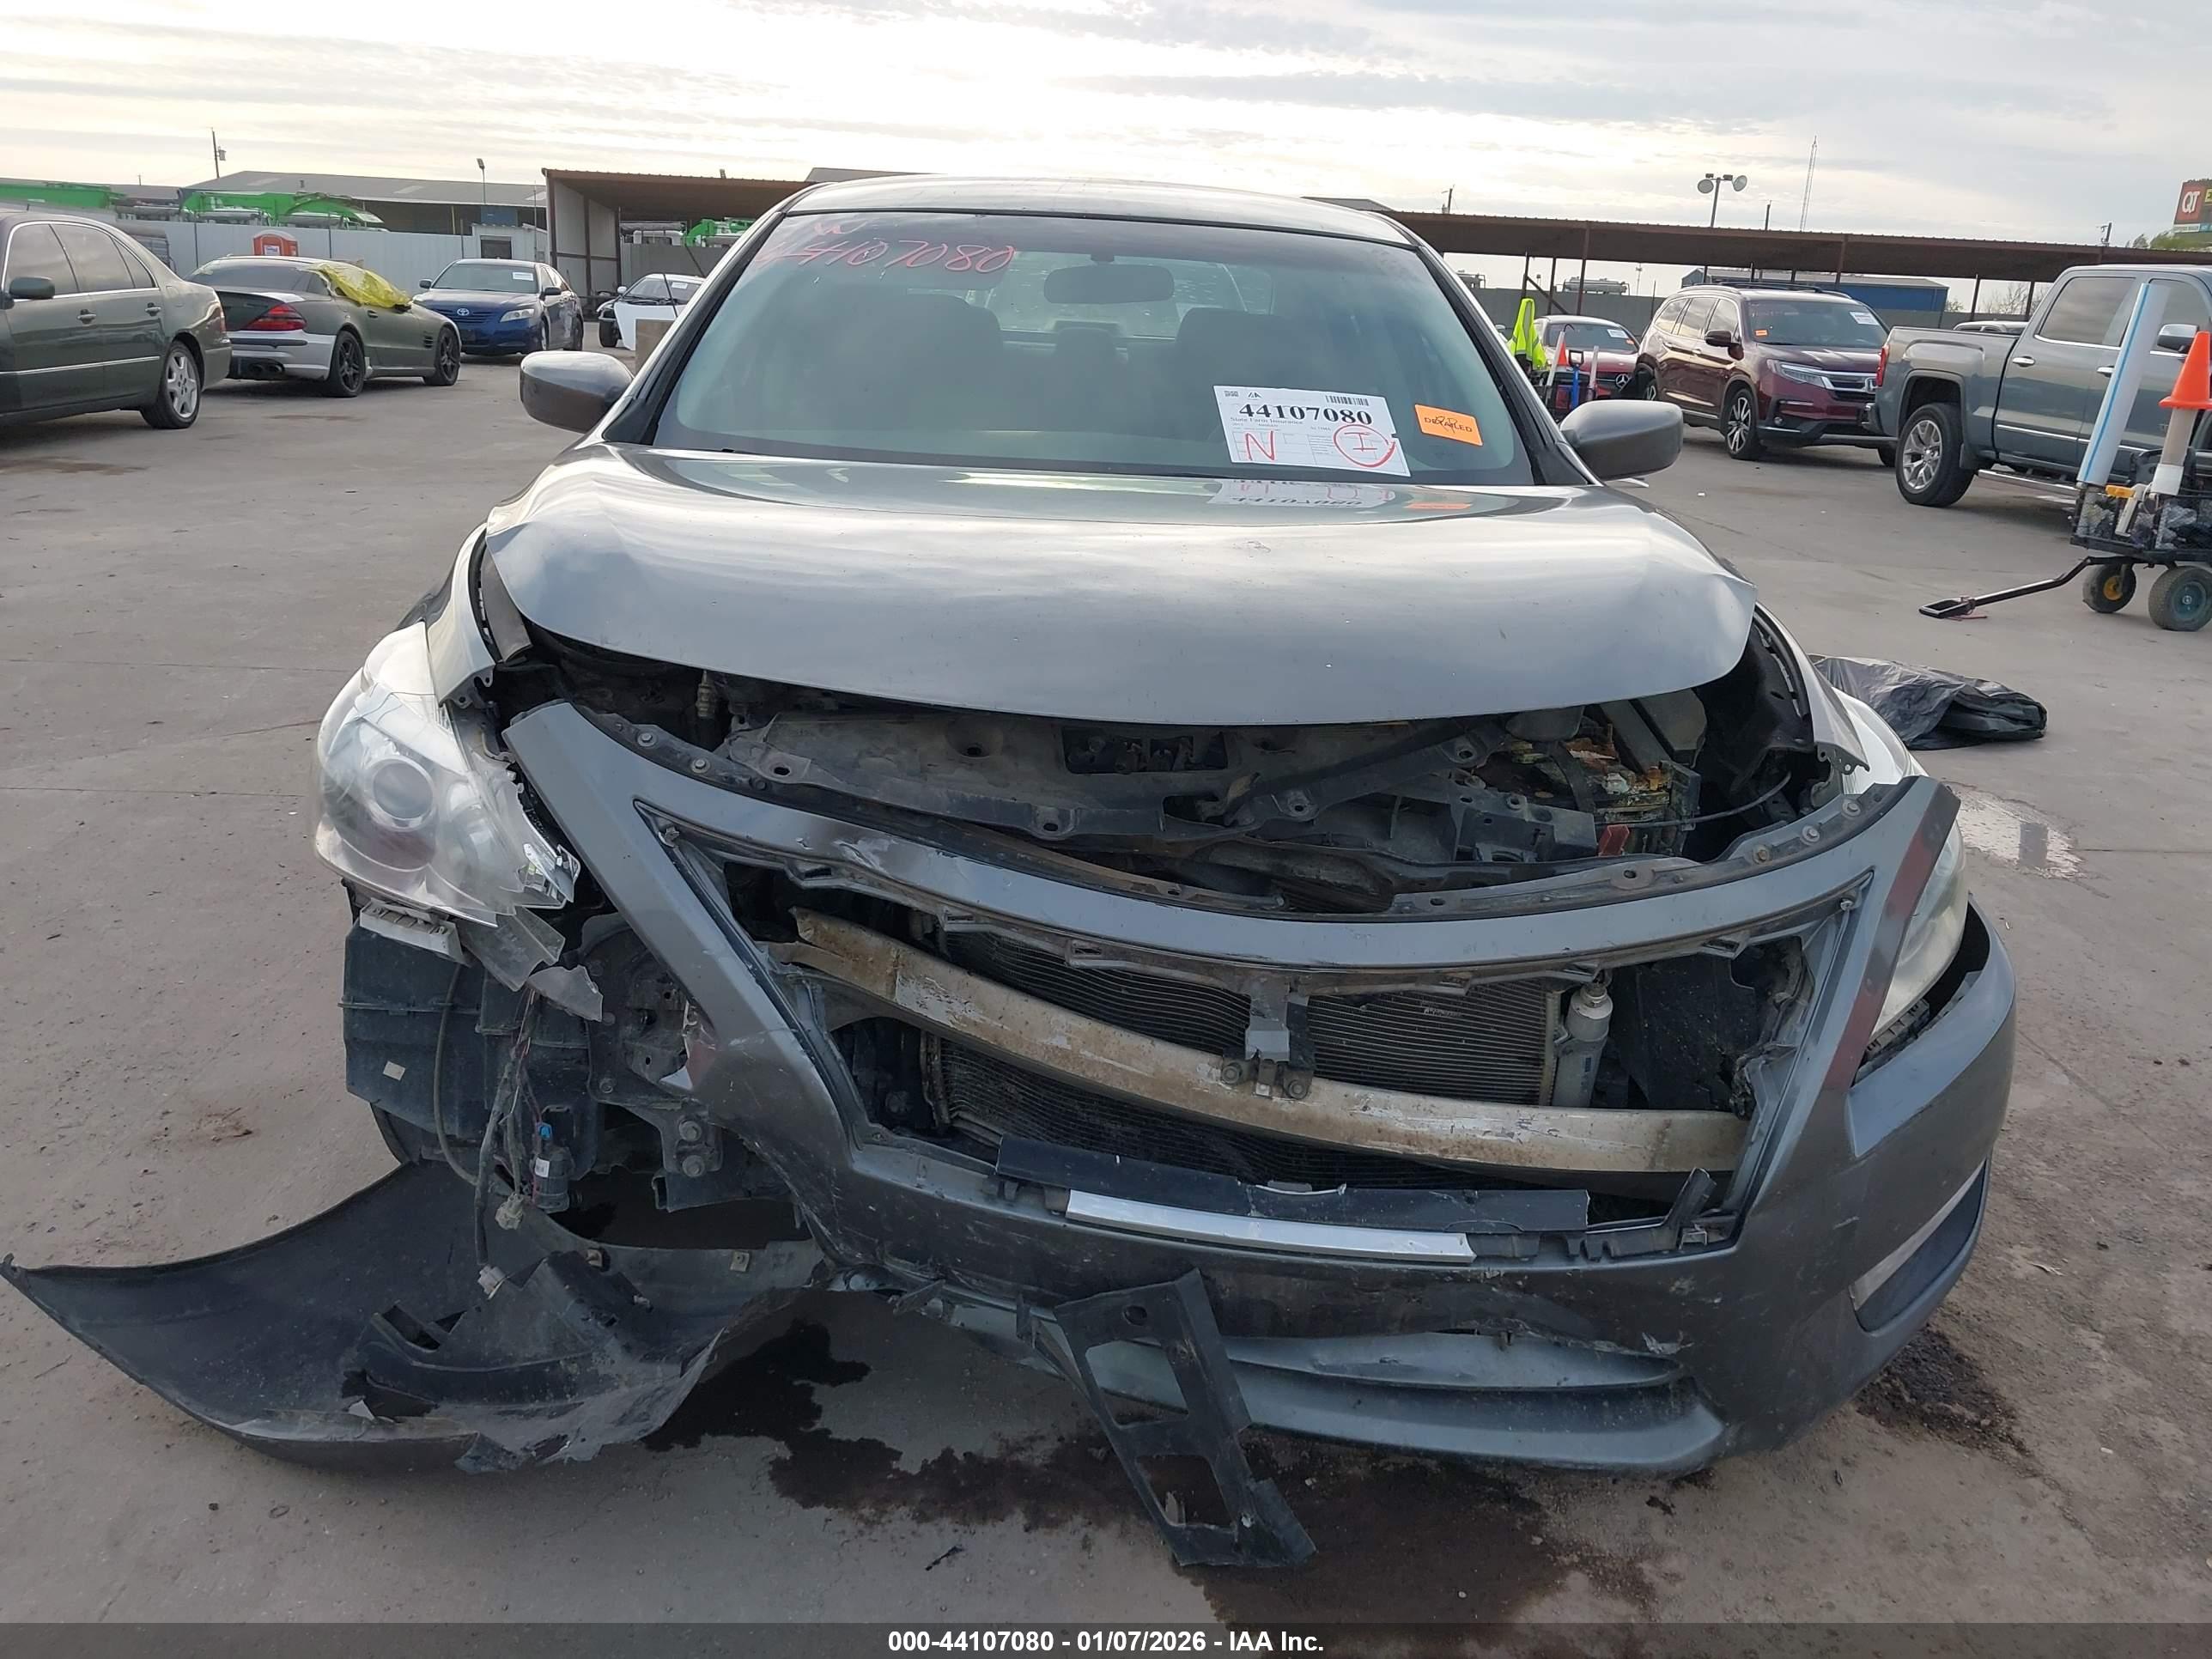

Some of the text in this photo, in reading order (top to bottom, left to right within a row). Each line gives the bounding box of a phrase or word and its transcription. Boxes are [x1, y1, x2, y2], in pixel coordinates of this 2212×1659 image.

[2182, 191, 2201, 214] QT
[1238, 404, 1372, 425] 44107080
[1245, 430, 1275, 461] N
